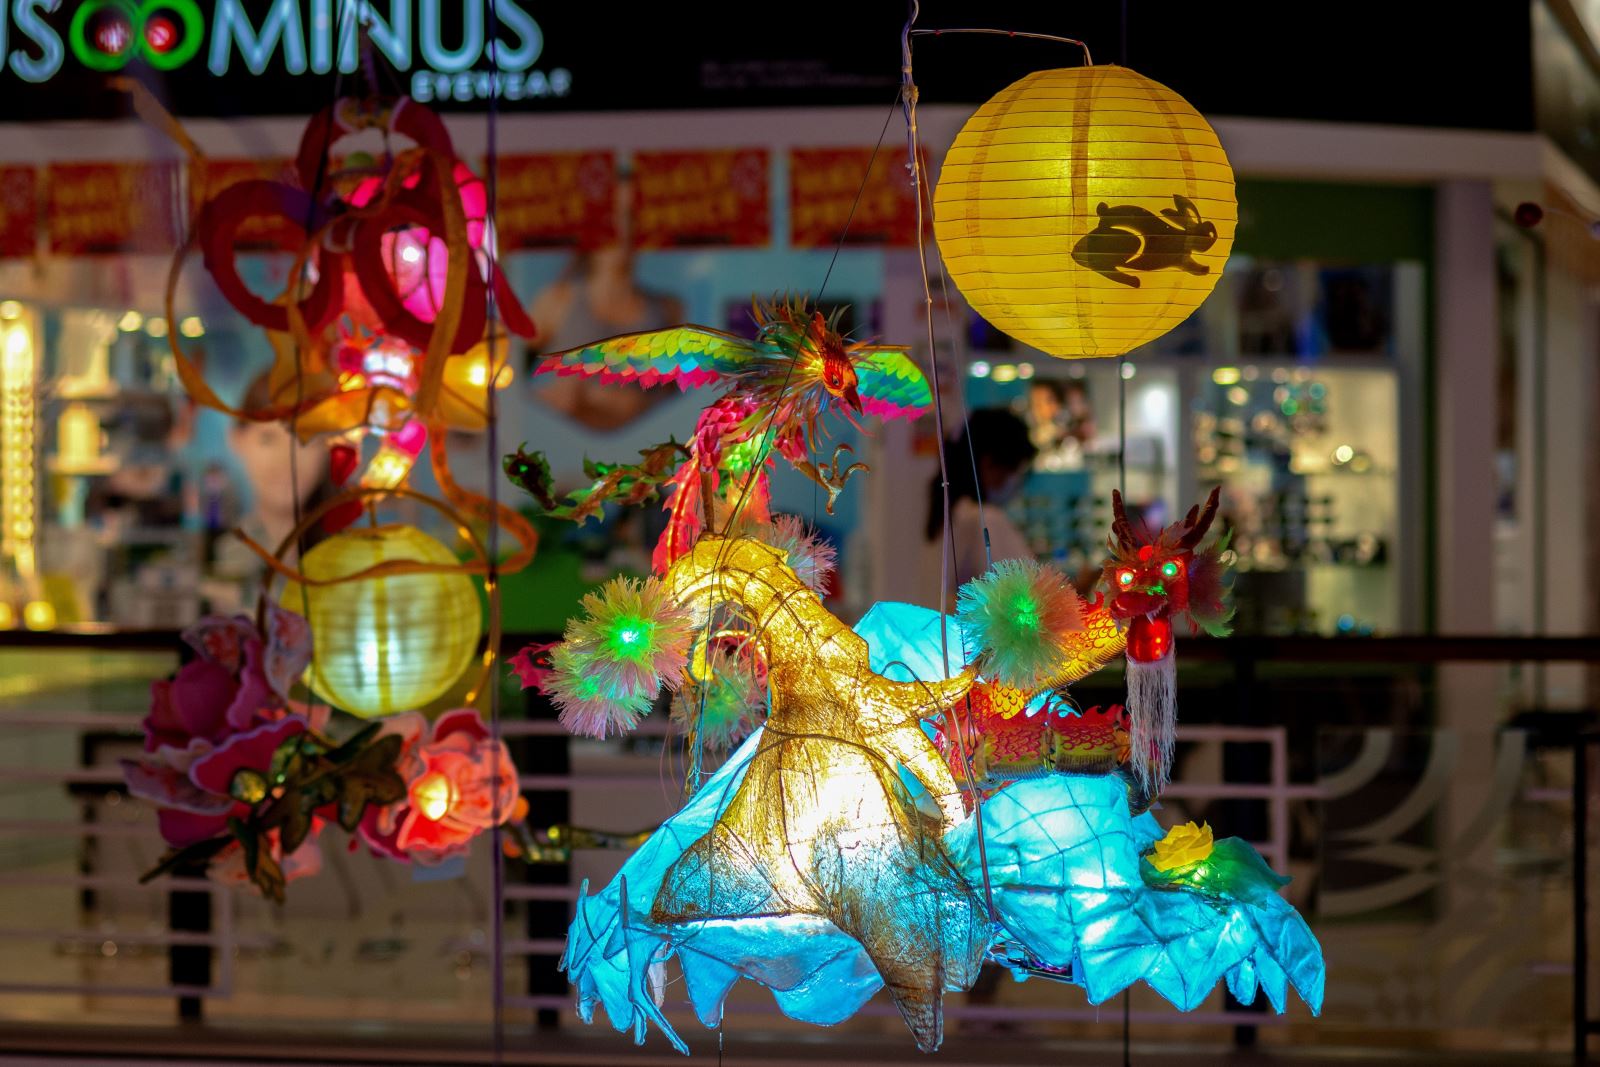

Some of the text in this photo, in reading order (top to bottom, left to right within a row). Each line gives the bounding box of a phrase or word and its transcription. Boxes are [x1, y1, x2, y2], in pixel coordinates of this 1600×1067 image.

[0, 0, 543, 83] S MINUS
[411, 69, 572, 102] EYEWEAR
